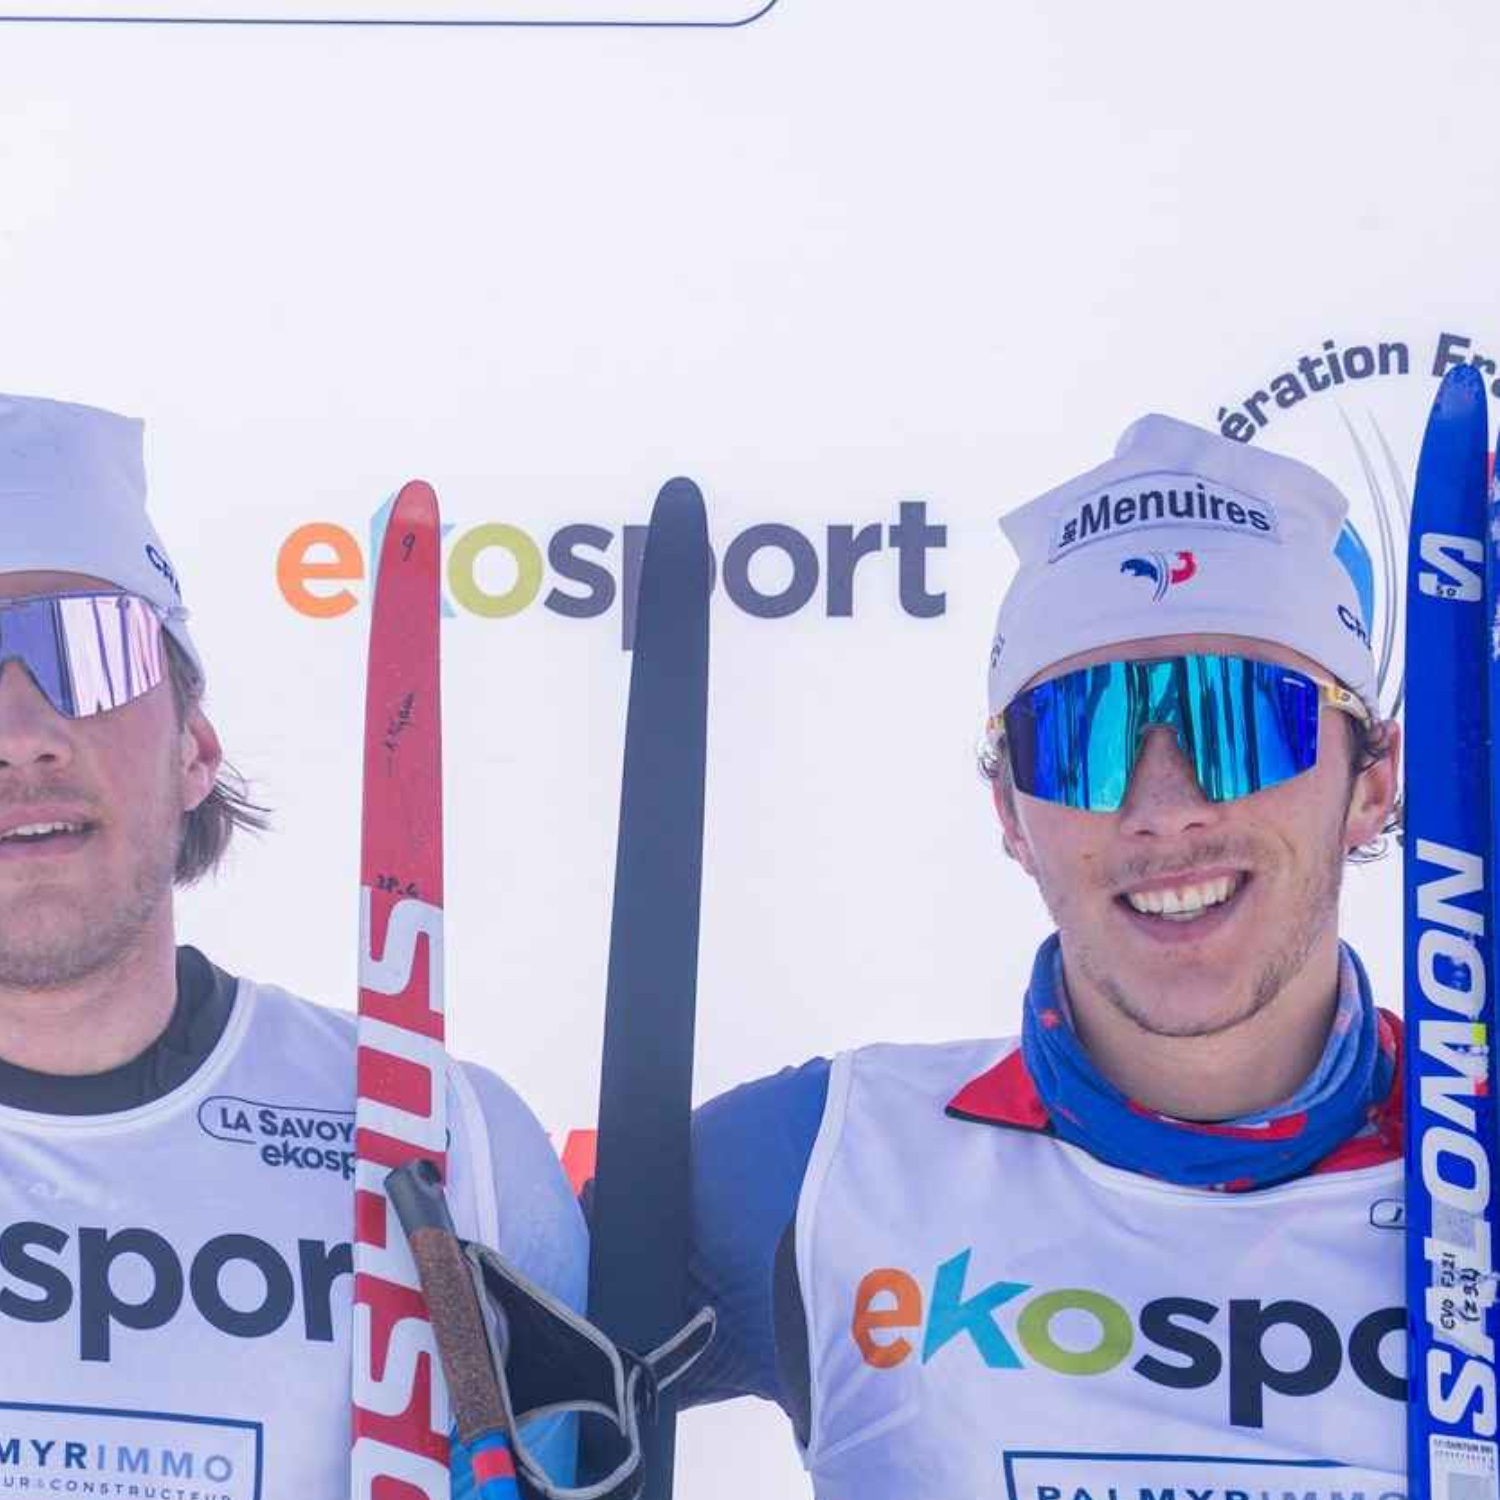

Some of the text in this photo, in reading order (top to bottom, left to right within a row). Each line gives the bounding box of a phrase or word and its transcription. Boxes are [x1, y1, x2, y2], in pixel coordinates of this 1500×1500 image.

[1431, 332, 1500, 399] Fr
[1079, 483, 1271, 539] Menuires
[277, 501, 946, 650] eosort
[220, 1107, 253, 1133] LA
[1416, 838, 1498, 1438] SALOMON
